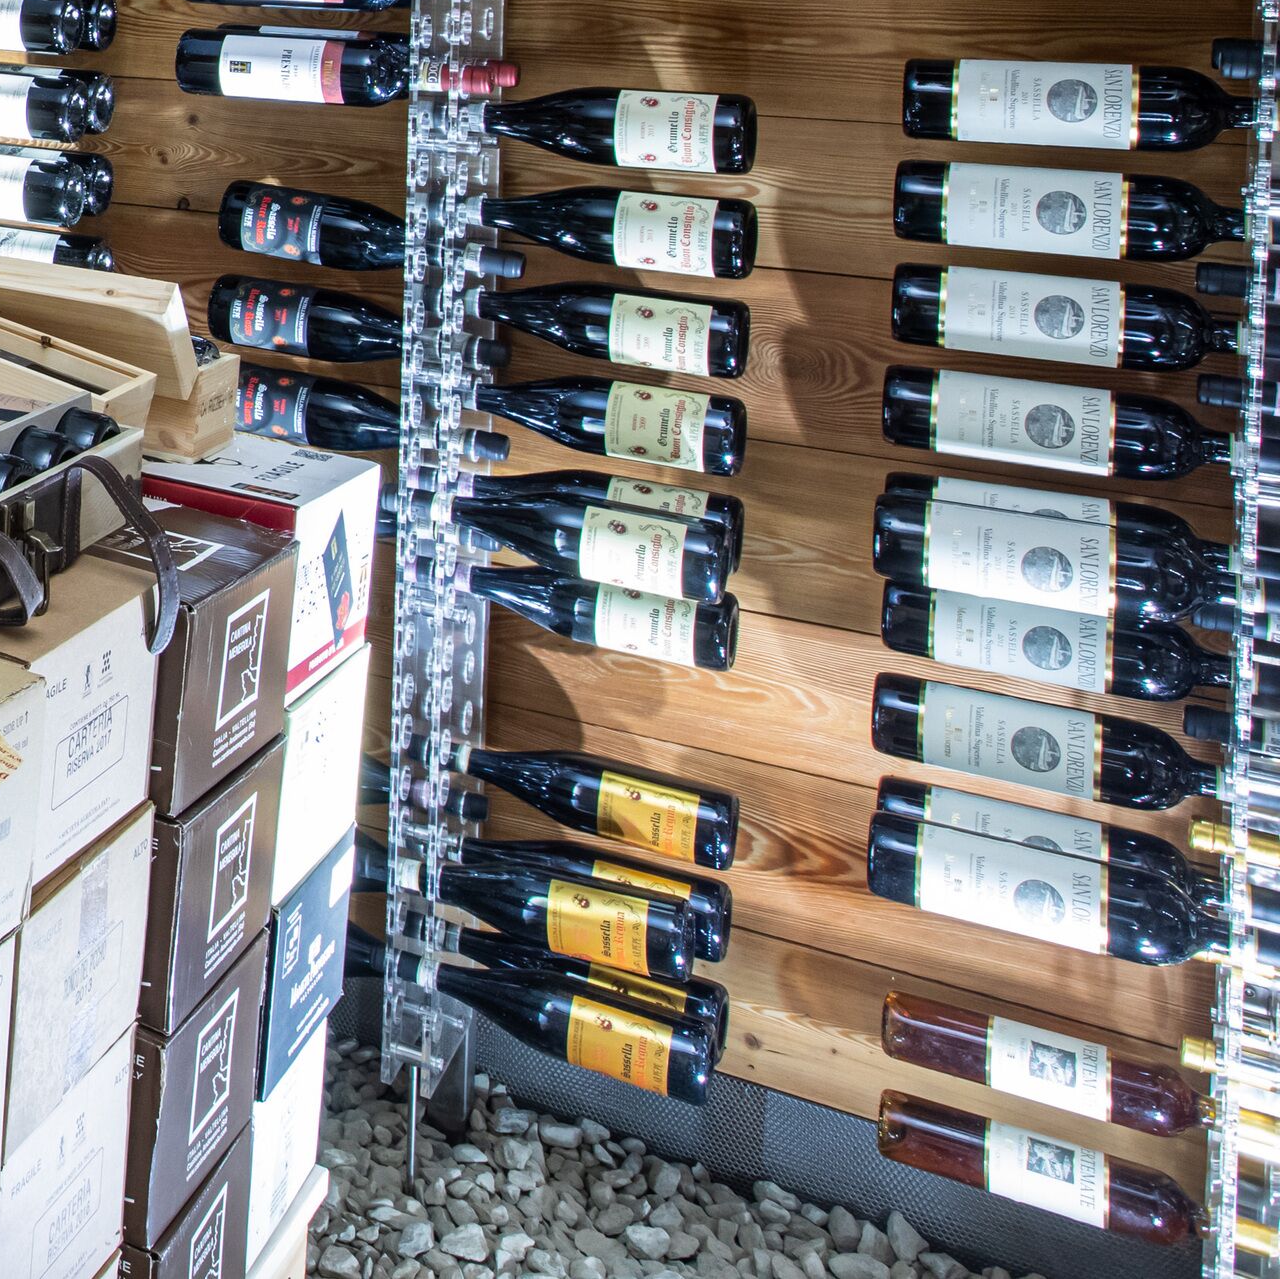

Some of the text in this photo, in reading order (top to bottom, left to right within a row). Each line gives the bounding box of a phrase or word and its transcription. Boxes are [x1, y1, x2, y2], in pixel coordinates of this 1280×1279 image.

[1102, 92, 1121, 140] LORENZO
[667, 216, 679, 259] Grumello
[1019, 290, 1029, 336] SASSELLA
[1089, 285, 1108, 357] SAN LORENZO
[255, 460, 305, 483] FRAGILE
[230, 621, 251, 644] CANTINA
[1080, 617, 1098, 640] SAN
[228, 637, 253, 661] MENEGOLA
[45, 678, 68, 700] AGILE
[66, 728, 113, 779] RISERVA 2017
[133, 837, 149, 861] ALTO
[218, 842, 242, 873] MENEGOLA
[219, 827, 240, 857] CANTINA
[200, 1026, 222, 1058] CANTINA
[200, 1042, 223, 1075] MENEGOLA
[192, 1225, 212, 1258] CANTINA
[192, 1238, 216, 1277] MENEGOLA
